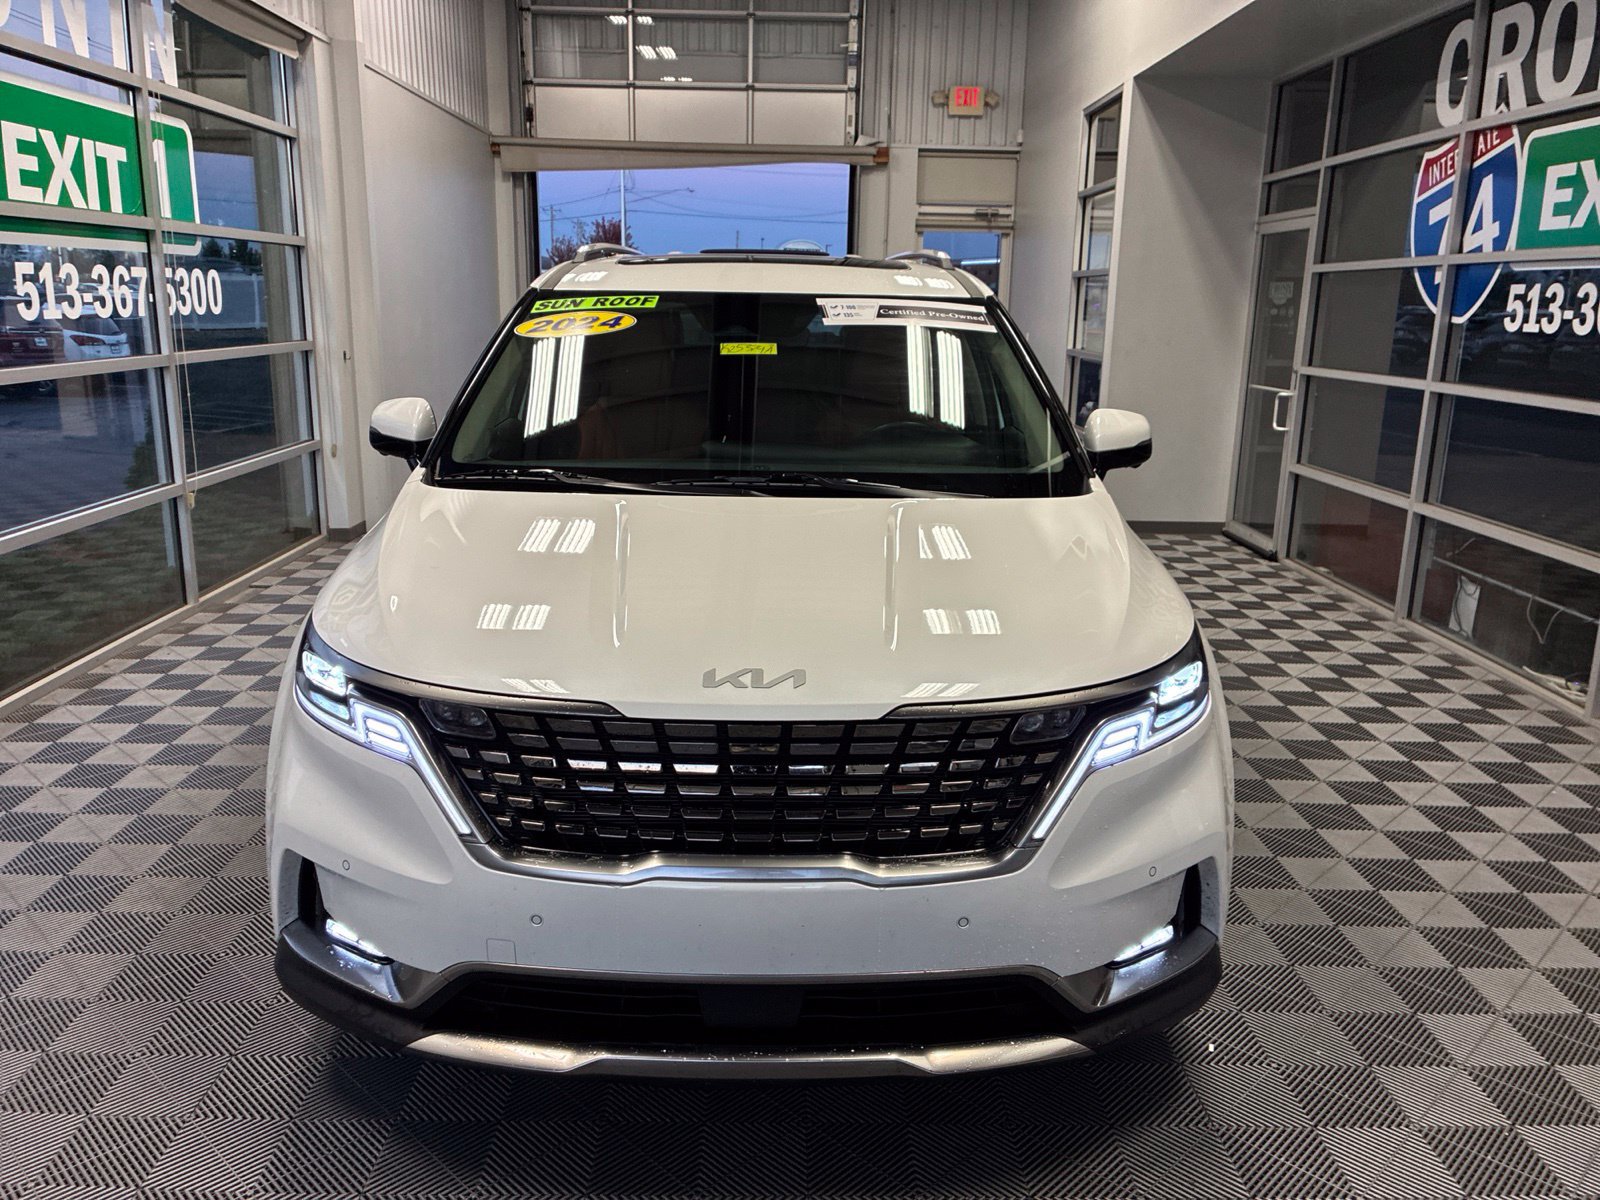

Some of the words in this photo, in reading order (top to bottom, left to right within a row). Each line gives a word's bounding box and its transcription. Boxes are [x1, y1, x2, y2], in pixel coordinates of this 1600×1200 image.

[1436, 0, 1600, 128] CRO
[955, 87, 979, 107] EXIT
[1, 121, 127, 214] EXIT
[1429, 129, 1501, 186] INTEATE
[1428, 173, 1500, 285] 74
[14, 261, 223, 321] 513-367-5300
[535, 299, 585, 311] SUN
[592, 296, 655, 307] ROOF
[880, 308, 926, 317] Certified
[928, 310, 985, 321] Pre-Owned
[1503, 282, 1600, 336] 513-3
[525, 315, 625, 334] 2024
[702, 667, 806, 689] KIA
